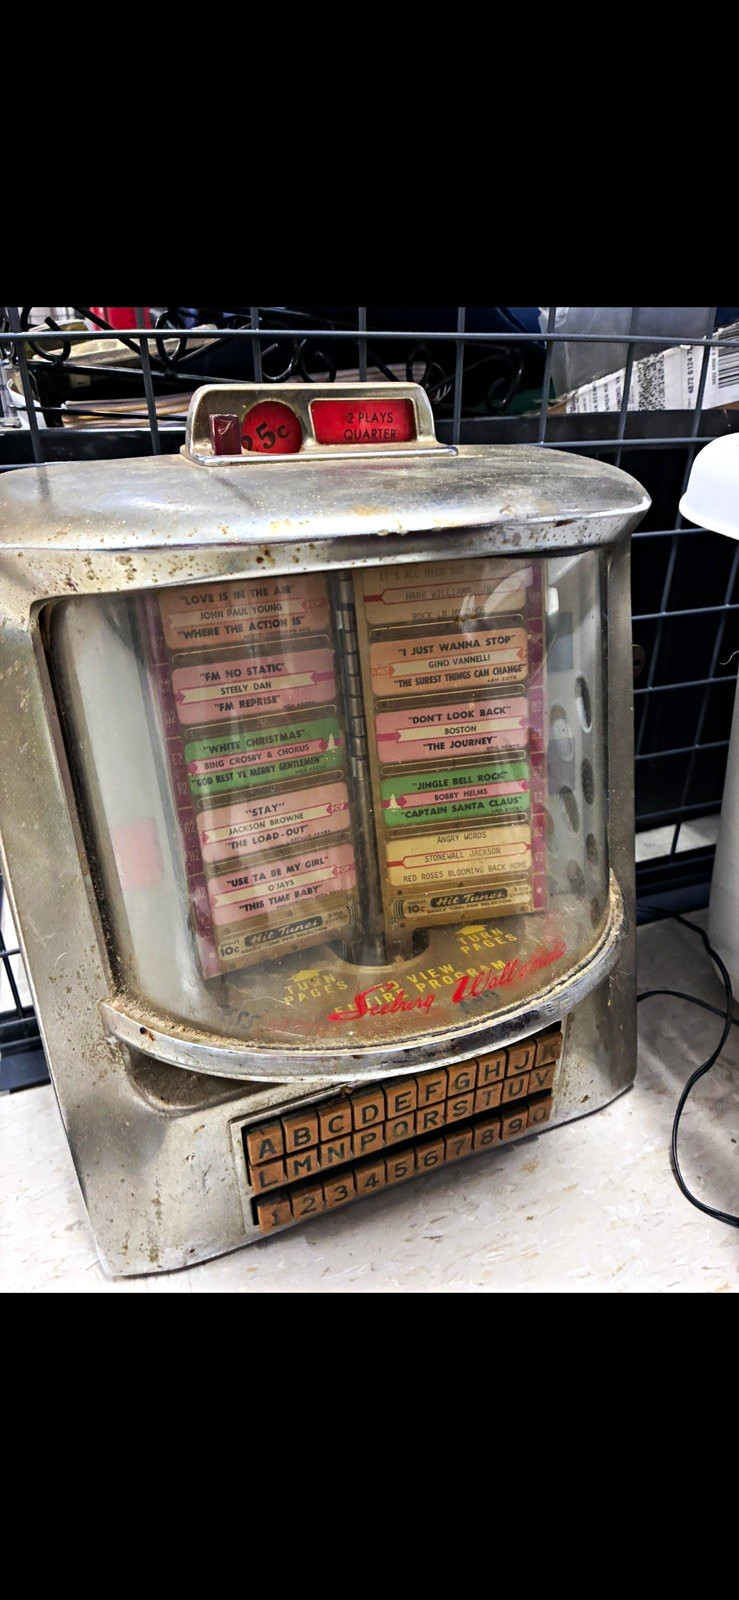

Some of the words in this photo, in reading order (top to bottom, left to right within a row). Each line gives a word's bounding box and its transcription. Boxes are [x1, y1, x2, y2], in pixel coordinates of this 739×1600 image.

[346, 412, 354, 424] 2
[358, 412, 394, 424] PLAYS
[343, 428, 397, 441] QUARTER
[380, 572, 400, 582] IT'S
[404, 570, 420, 579] ALL
[425, 568, 446, 578] OVER
[219, 592, 228, 602] IS
[234, 590, 244, 600] IN
[250, 587, 268, 598] THE
[406, 591, 426, 600] HANK
[200, 611, 224, 620] JOHN
[227, 608, 249, 618] PAUL
[252, 603, 282, 615] YOUNG
[412, 612, 432, 621] ROCK
[438, 610, 448, 618] IN
[224, 624, 243, 634] THE
[249, 619, 288, 631] ACTION
[411, 645, 434, 656] JUST
[439, 640, 480, 652] WANNA
[486, 634, 516, 646] STOP"
[428, 660, 450, 669] GINO
[453, 655, 491, 666] VANNELLI
[226, 668, 242, 678] NO
[246, 662, 286, 675] STATIC"
[416, 675, 441, 686] SUREST
[445, 671, 471, 682] THINGS
[474, 669, 490, 678] CAN
[493, 663, 527, 676] CHANGE"
[220, 684, 248, 695] STEELY
[254, 681, 272, 690] DAN
[240, 695, 281, 709] REPRISE"
[447, 710, 474, 720] LOOK
[480, 706, 511, 717] BACK"
[445, 726, 477, 735] BOSTON
[246, 729, 305, 748] CHRISTMAS"
[450, 736, 497, 748] JOURNEY"
[204, 760, 224, 770] BING
[230, 751, 263, 765] CROSBY
[278, 744, 310, 757] CHORUS
[215, 773, 234, 784] REST
[238, 770, 247, 779] YE
[250, 766, 276, 777] MERRY
[412, 779, 448, 790] "JINGLE
[452, 777, 473, 786] BELL
[434, 792, 458, 801] BOBBY
[464, 788, 488, 798] HELMS
[246, 802, 285, 817] "STAY"
[452, 802, 484, 813] SANTA
[228, 821, 266, 835] JACKSON
[270, 813, 304, 827] BROWNE
[437, 834, 459, 844] ANGRY
[464, 831, 486, 840] WORDS
[425, 852, 464, 863] STONEWALL
[469, 848, 501, 858] JACKSON
[253, 872, 266, 881] TA
[271, 868, 282, 877] BE
[286, 864, 300, 873] MY
[403, 874, 417, 882] RED
[421, 871, 444, 880] ROSES
[448, 867, 484, 877] BLOOMING
[488, 864, 506, 872] BACK
[510, 861, 527, 869] HOME
[268, 879, 294, 892] O'JAYS
[268, 893, 290, 905] TIME
[295, 884, 322, 899] BABY"
[463, 891, 506, 903] Tunes
[278, 920, 319, 936] Tunes
[457, 928, 504, 945] TURN
[460, 934, 518, 954] PAGES
[407, 964, 455, 983] VIEW
[283, 981, 348, 1006] PAGES
[326, 981, 436, 1022] Seeburg
[258, 1138, 276, 1160] A
[293, 1126, 311, 1146] B
[328, 1114, 345, 1135] C
[361, 1104, 379, 1123] D
[394, 1091, 411, 1112] E
[425, 1080, 441, 1101] F
[454, 1072, 471, 1090] G
[484, 1060, 501, 1081] H
[514, 1050, 530, 1070] J
[259, 1170, 279, 1188] L
[294, 1159, 312, 1174] M
[327, 1144, 345, 1163] N
[360, 1132, 377, 1149] P
[423, 1110, 439, 1129] R
[452, 1100, 468, 1117] S
[482, 1090, 499, 1108] T
[509, 1080, 525, 1097] U
[535, 1070, 550, 1088] V
[299, 1196, 317, 1215] 2
[334, 1185, 349, 1202] 3
[364, 1173, 380, 1188] 4
[394, 1162, 408, 1177] 5
[423, 1150, 437, 1166] 6
[454, 1138, 468, 1154] 7
[481, 1129, 494, 1144] 8
[508, 1118, 523, 1135] 9
